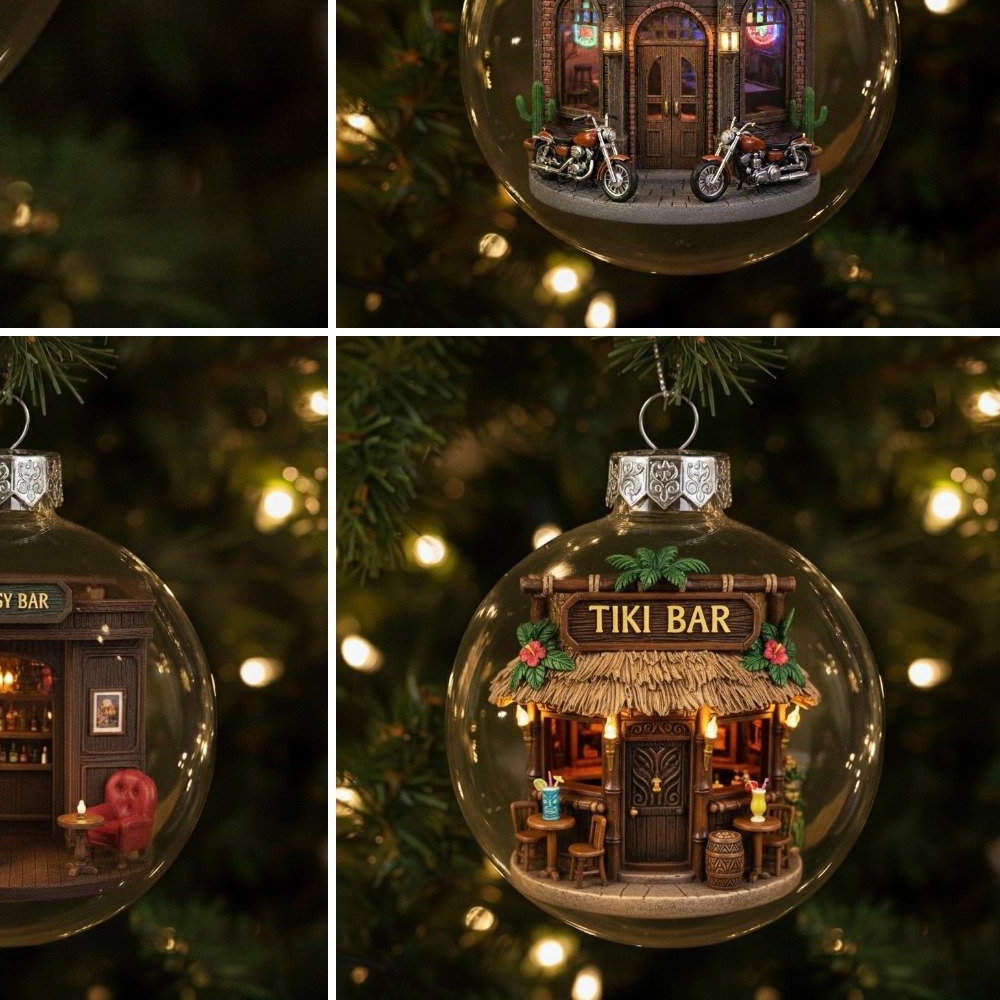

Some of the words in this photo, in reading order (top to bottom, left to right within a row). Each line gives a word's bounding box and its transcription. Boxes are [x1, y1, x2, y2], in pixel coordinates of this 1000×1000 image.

[18, 592, 49, 609] BAR
[588, 605, 651, 633] TIKI
[666, 605, 731, 633] BAR
